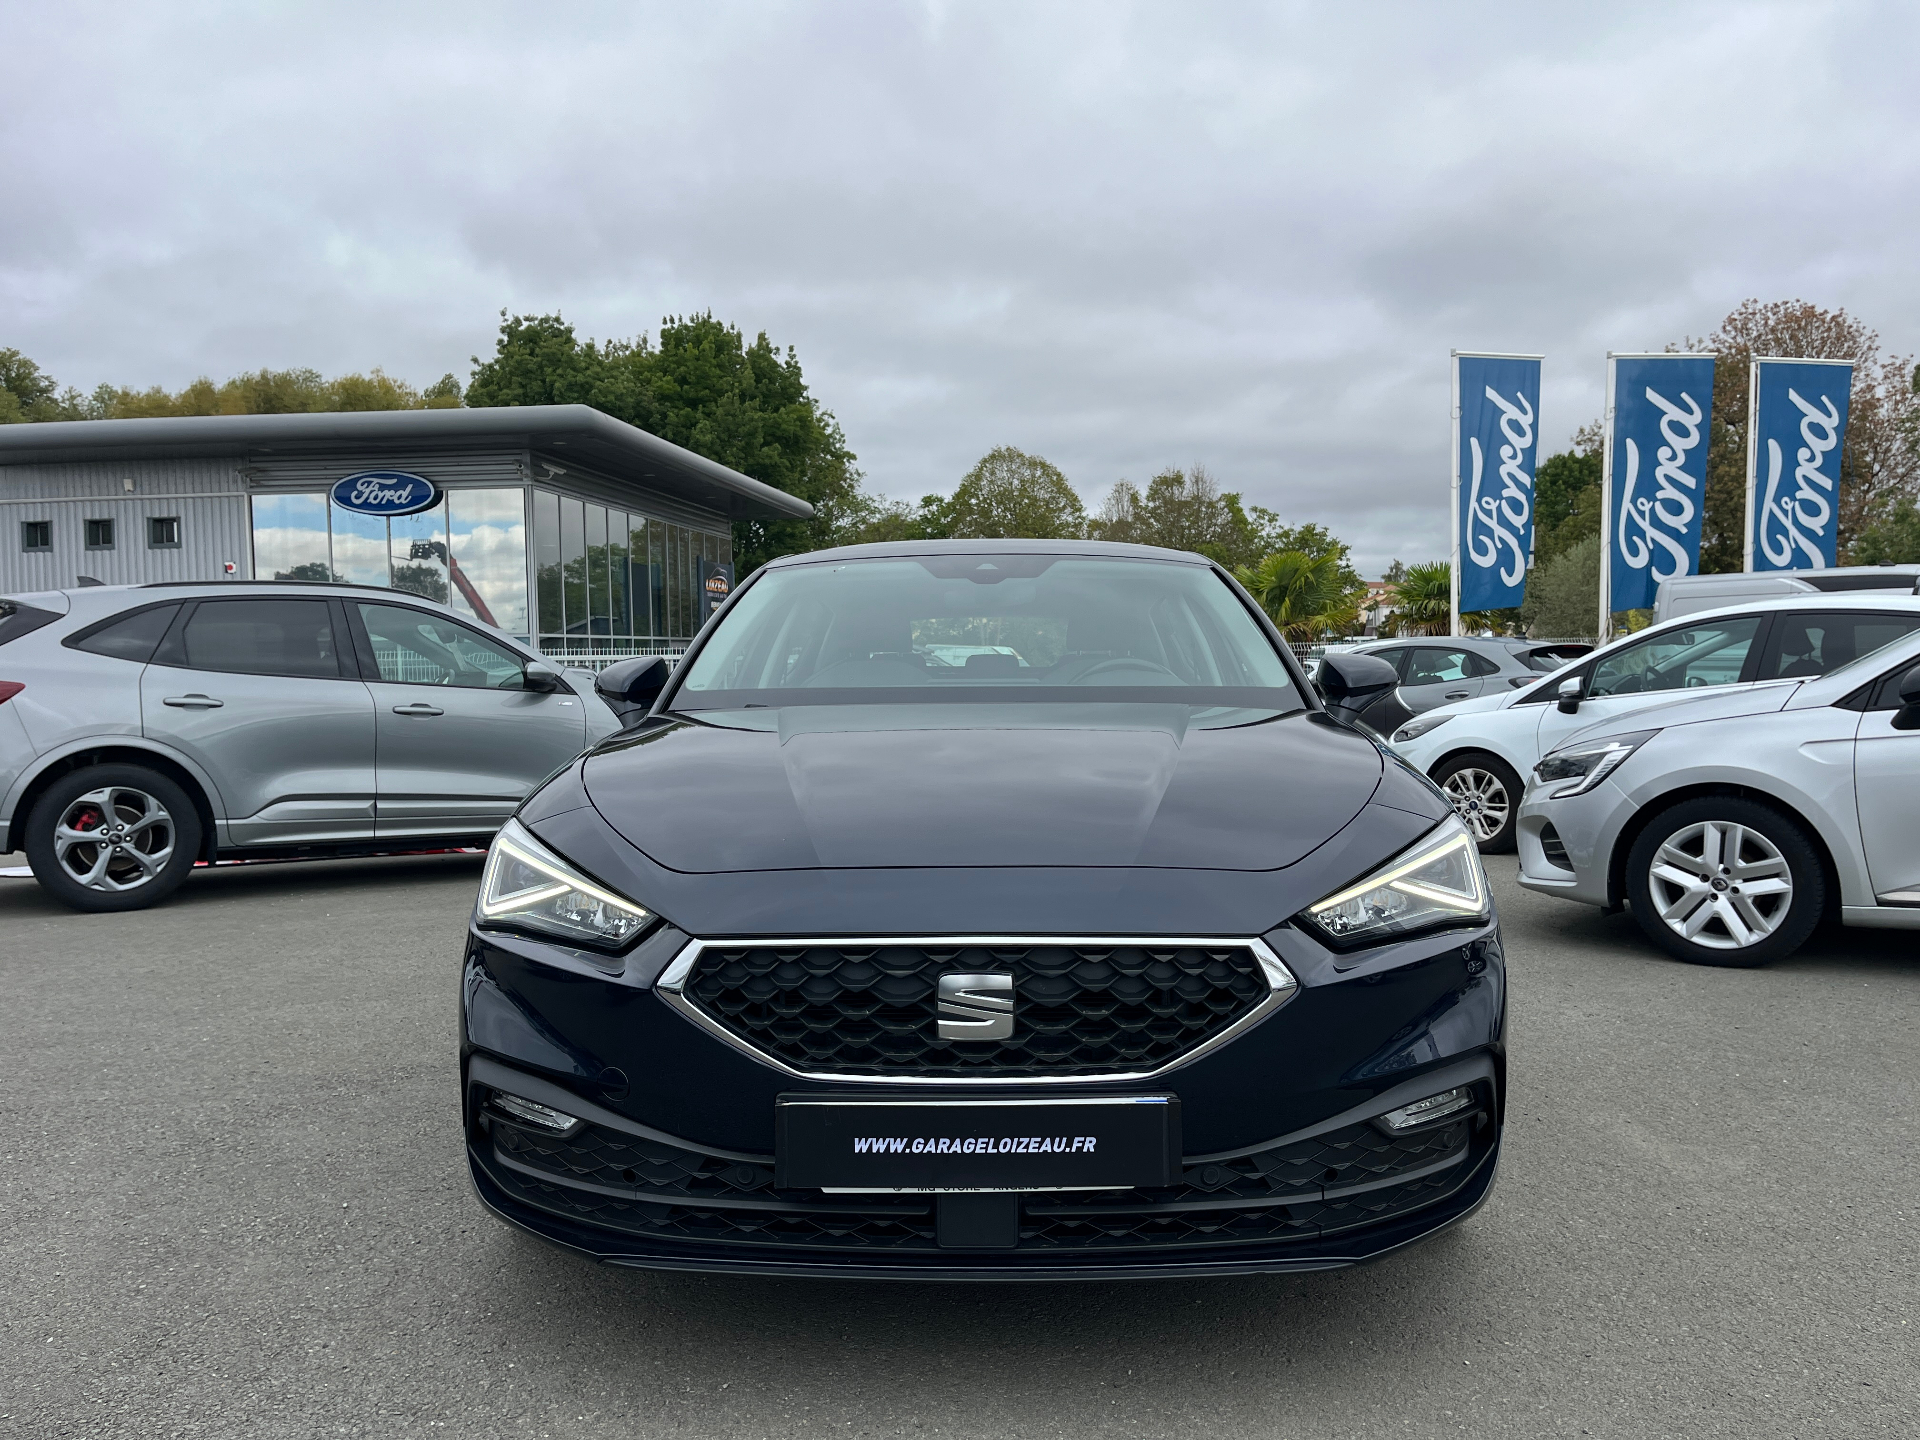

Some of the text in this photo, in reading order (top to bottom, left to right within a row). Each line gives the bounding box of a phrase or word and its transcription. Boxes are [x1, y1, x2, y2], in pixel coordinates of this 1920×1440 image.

[351, 477, 413, 505] Ford
[1467, 385, 1534, 587] Ford
[1619, 386, 1702, 583] Ford
[1760, 387, 1839, 569] Ford
[854, 1137, 1096, 1153] WWW.GARAGELOIZEAU.FR
